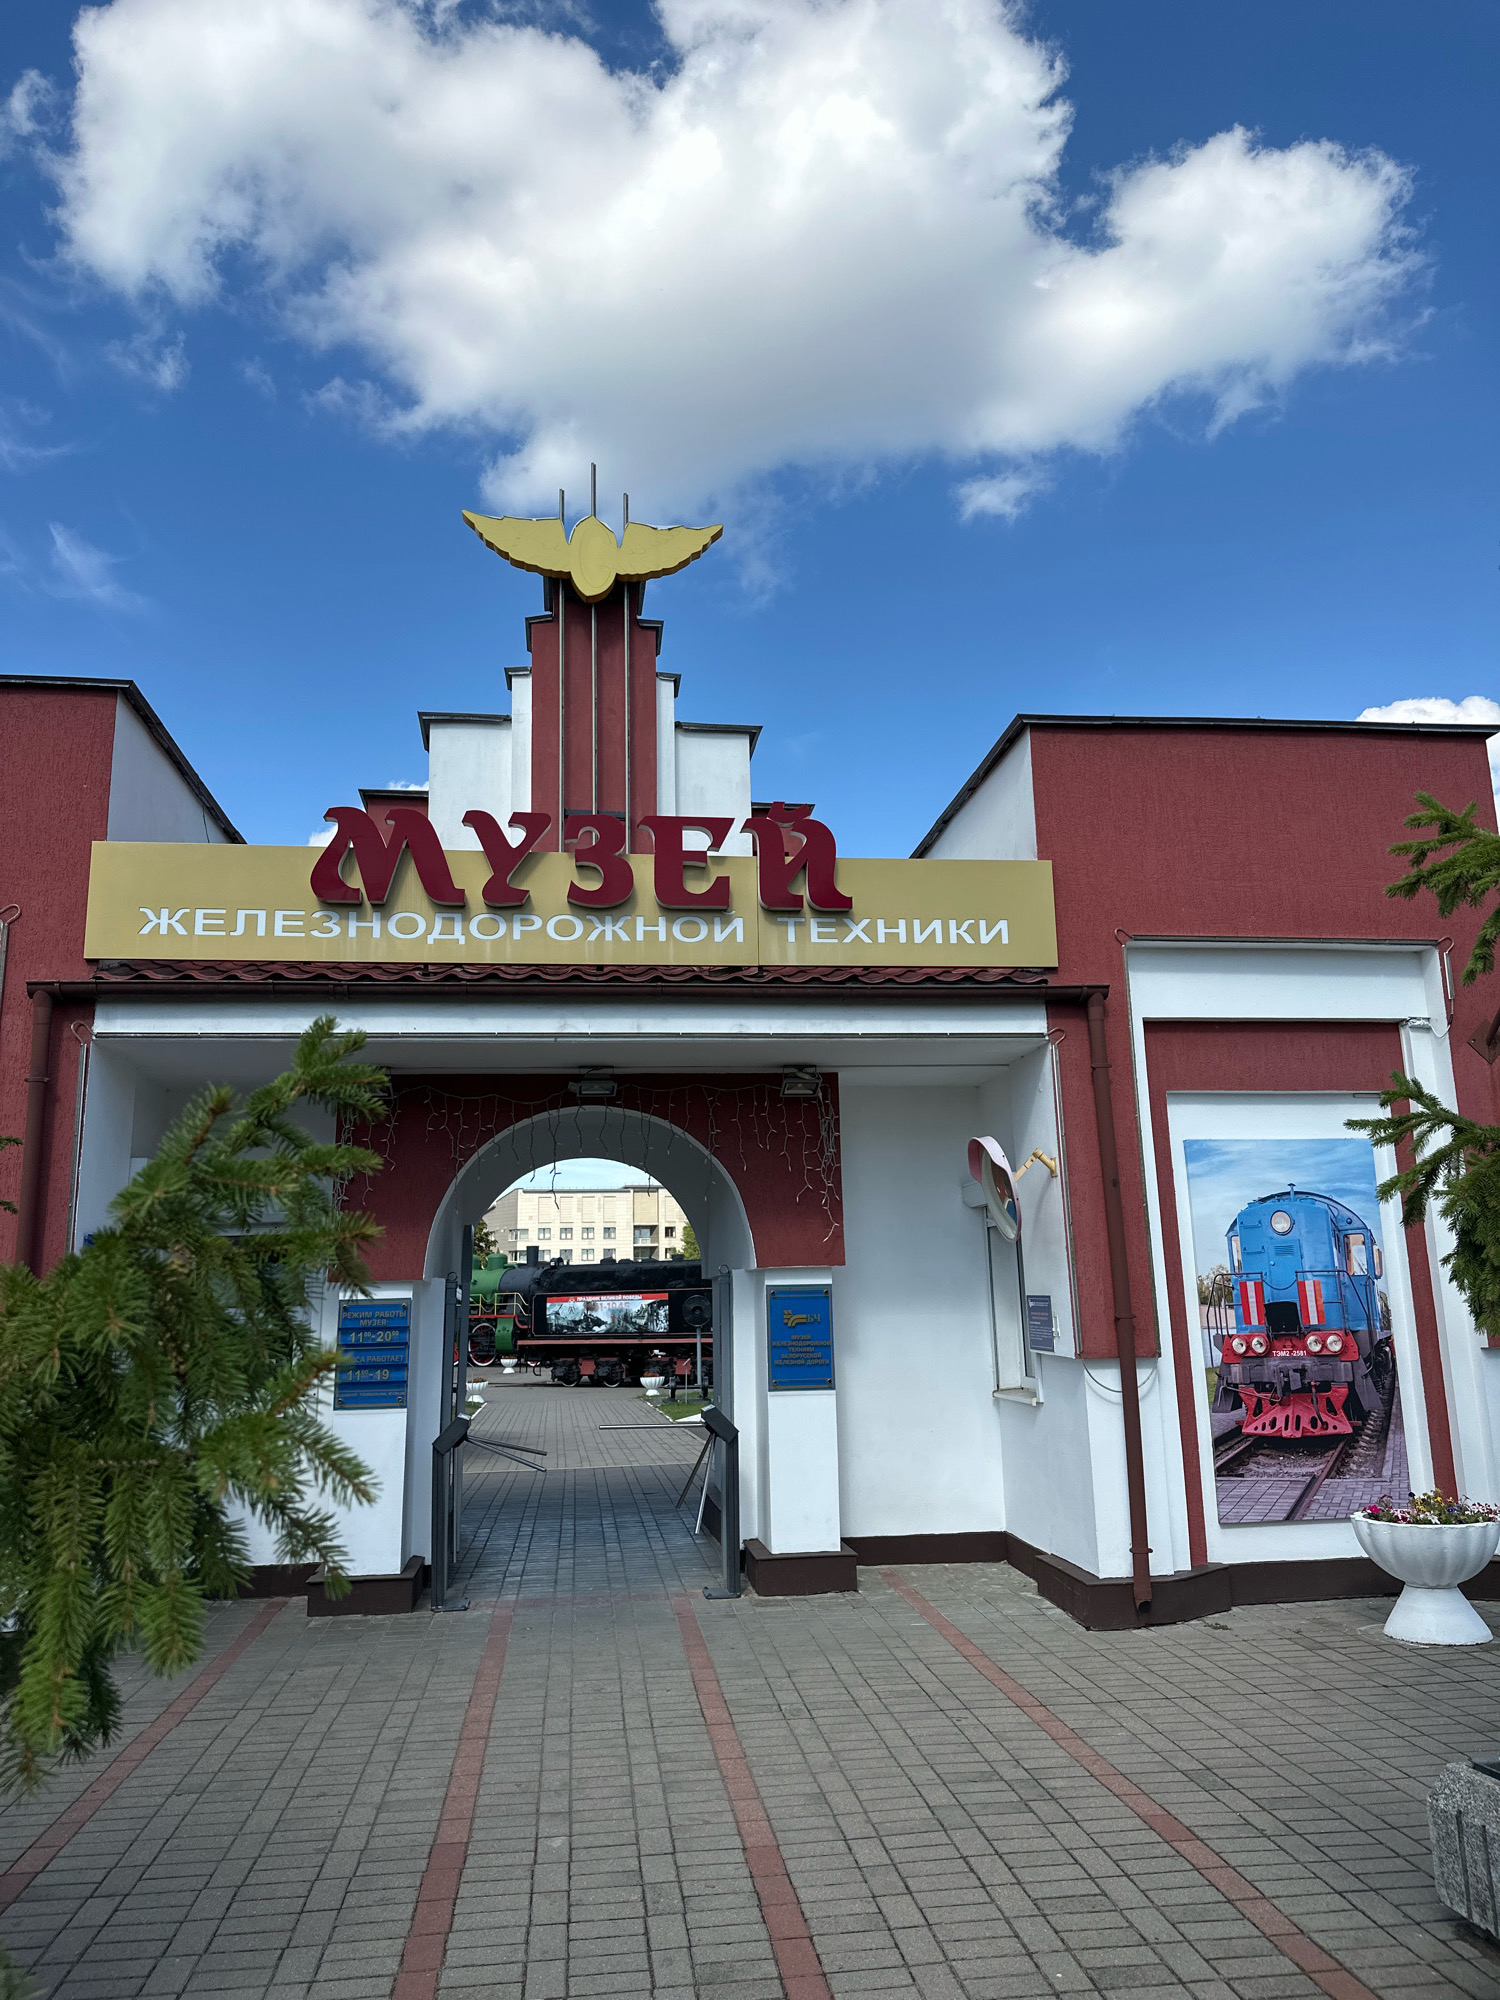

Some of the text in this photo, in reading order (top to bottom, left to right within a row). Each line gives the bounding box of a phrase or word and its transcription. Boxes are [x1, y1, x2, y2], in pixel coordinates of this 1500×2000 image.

[310, 801, 853, 911] МУЗЕЙ
[138, 907, 1010, 944] ЖЕЛЕЗНОДОРОЖНОЙ ТЕХНИКИ
[375, 1310, 406, 1318] РАБОТЫ
[583, 1301, 630, 1311] 1-1945
